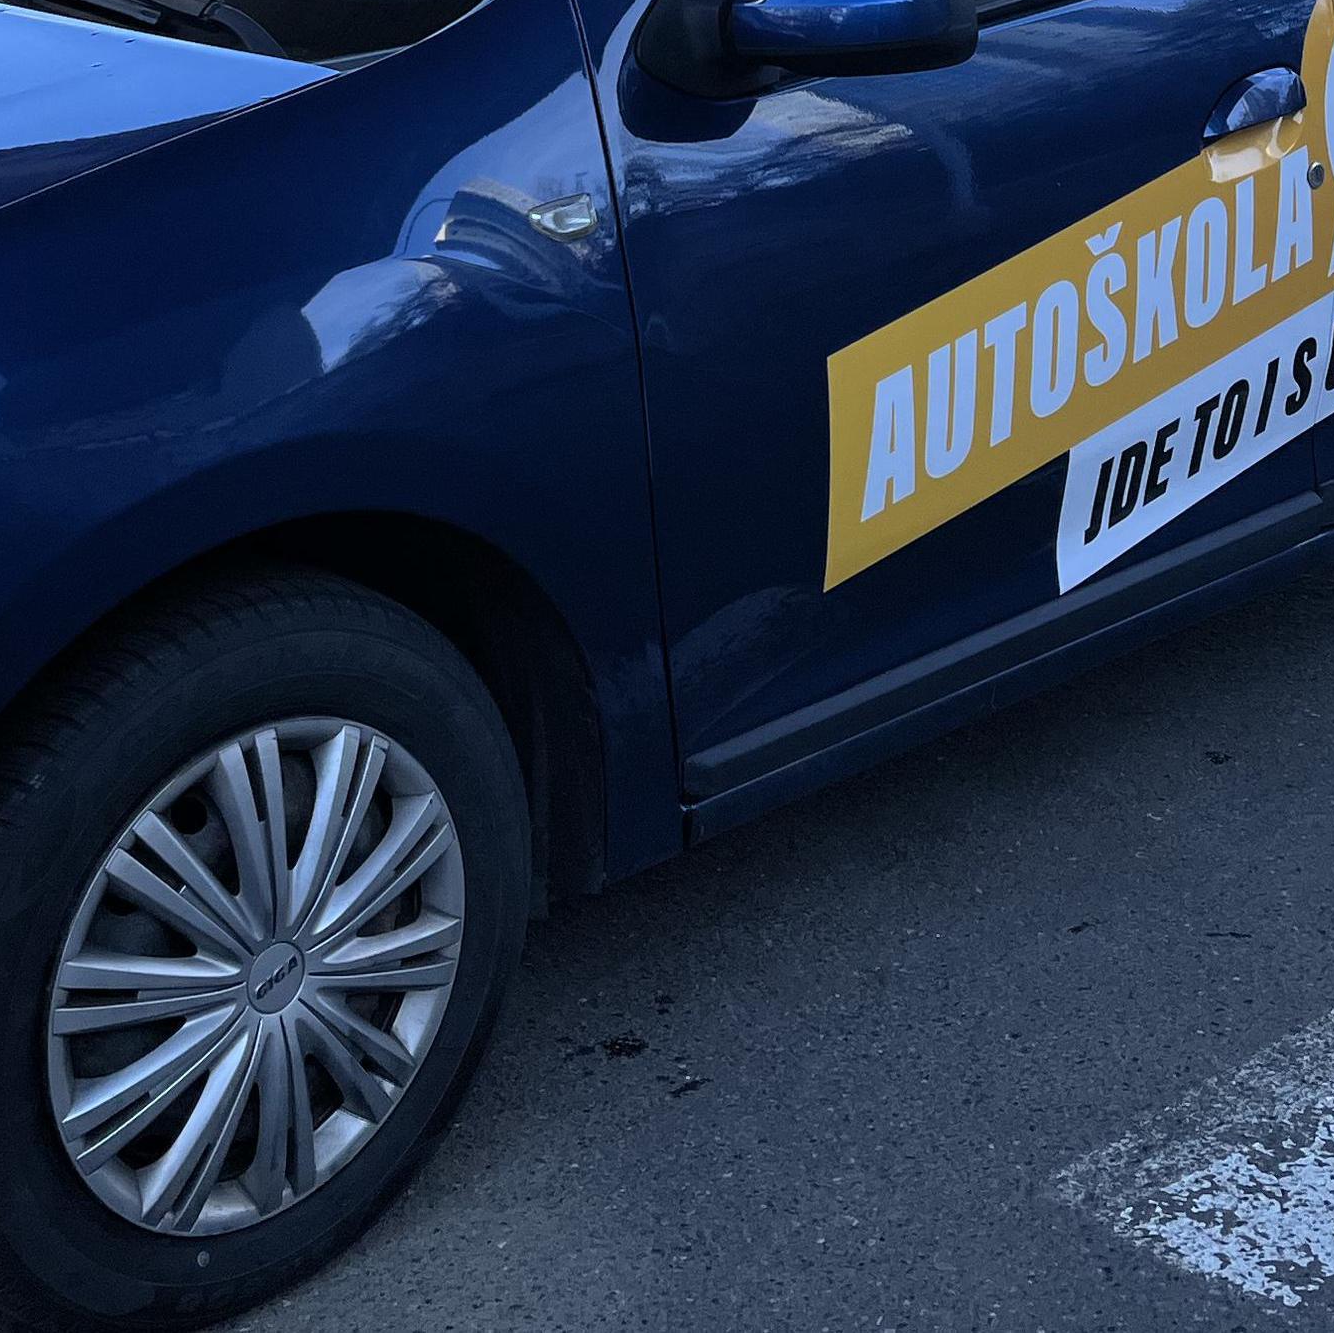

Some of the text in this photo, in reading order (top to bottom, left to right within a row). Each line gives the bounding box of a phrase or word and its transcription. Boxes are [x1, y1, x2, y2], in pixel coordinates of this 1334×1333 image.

[860, 147, 1314, 523] AUTOŠKOLA
[1083, 418, 1179, 546] JDE
[1188, 378, 1250, 480] TO
[1253, 357, 1280, 438] I
[1286, 337, 1317, 416] S
